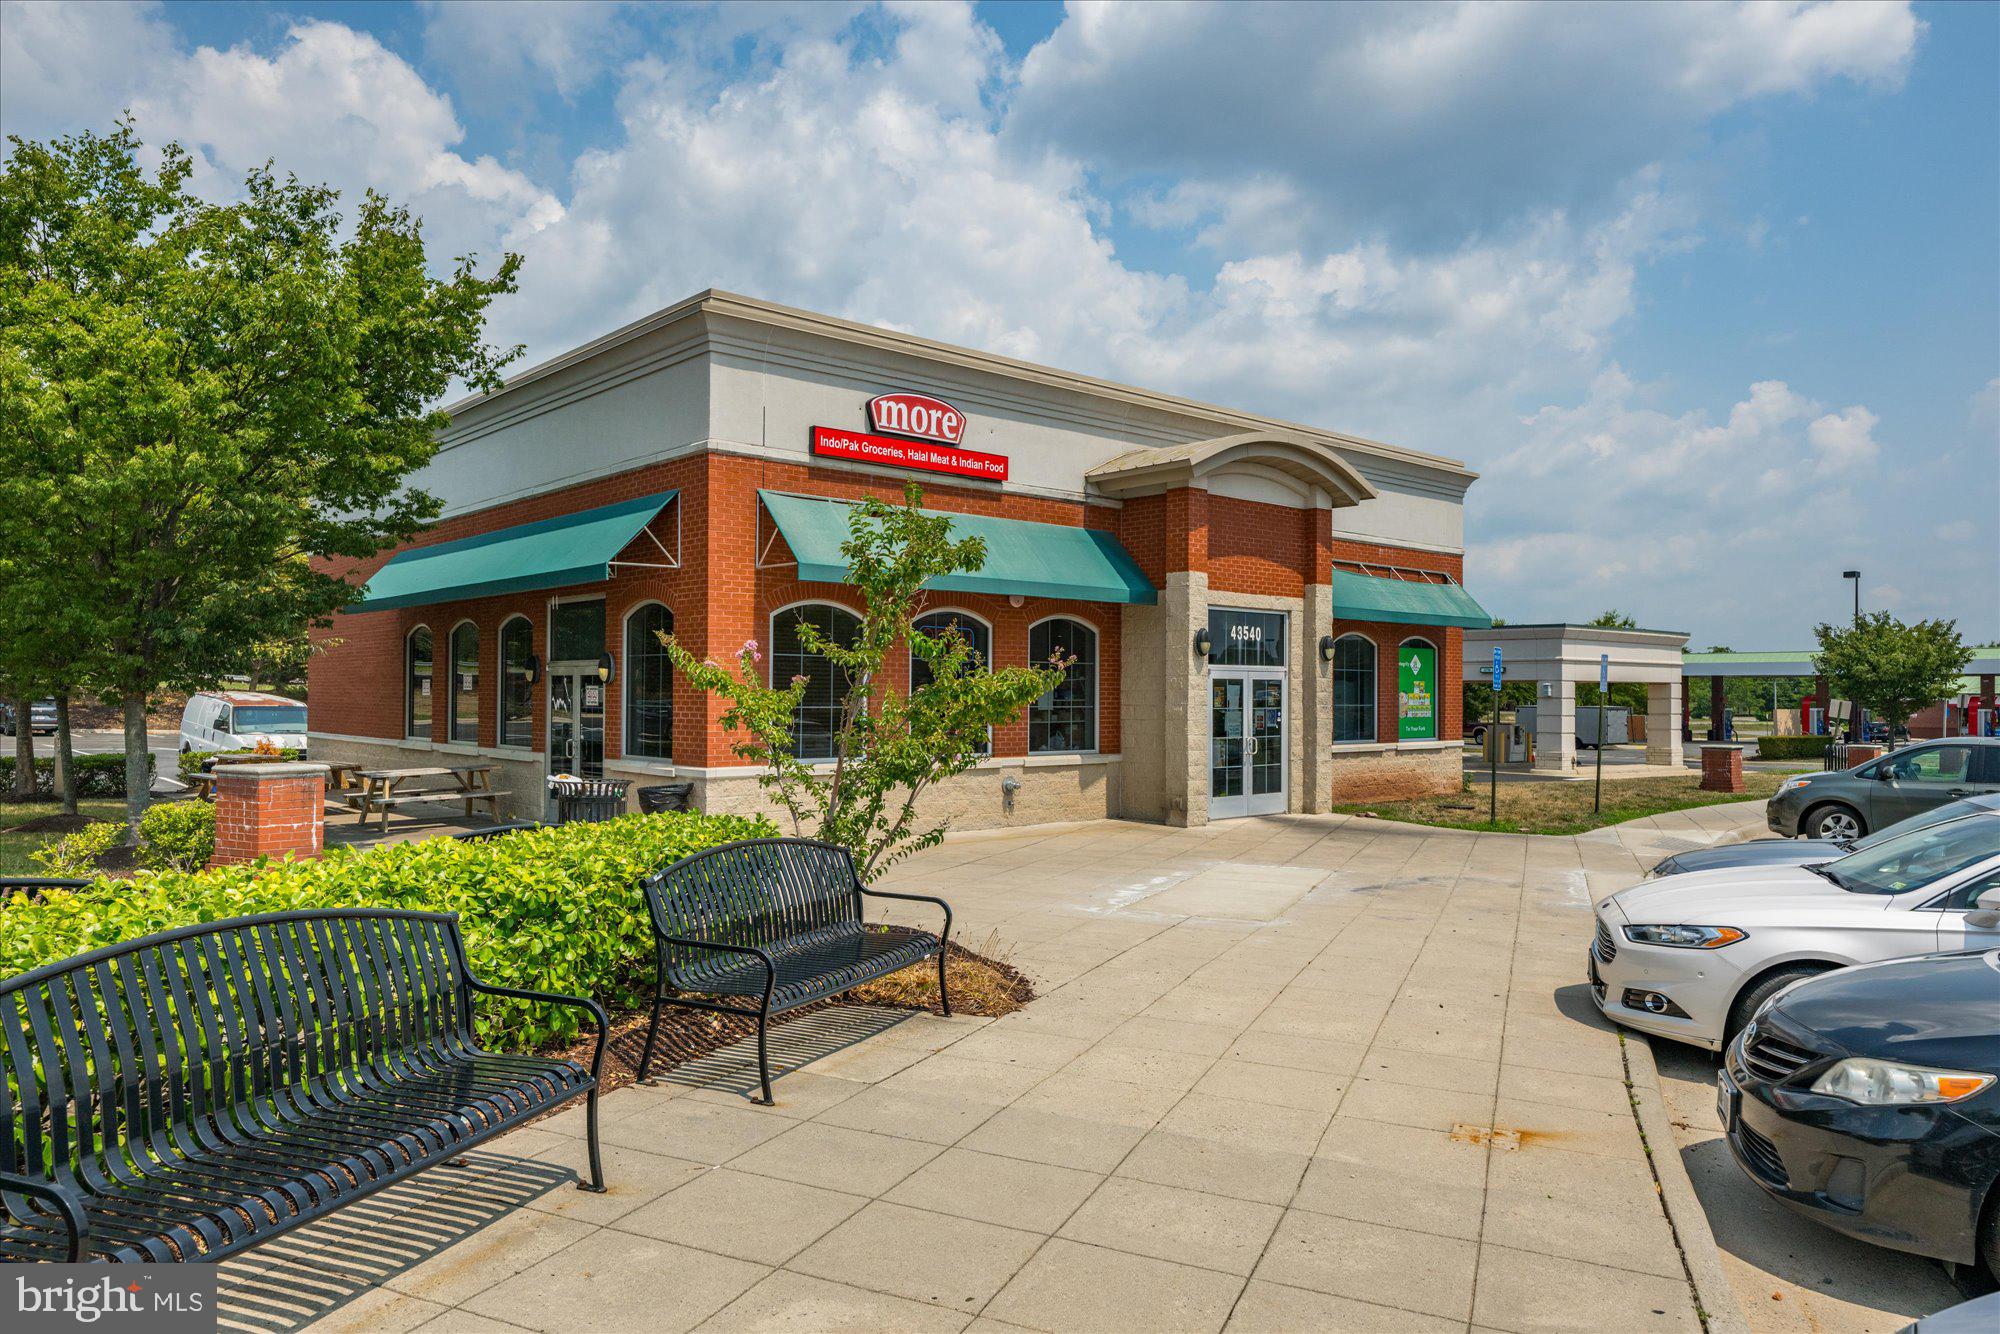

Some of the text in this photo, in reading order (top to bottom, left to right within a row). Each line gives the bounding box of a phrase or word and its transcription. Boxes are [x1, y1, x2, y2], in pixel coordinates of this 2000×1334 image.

[879, 400, 957, 438] more
[820, 435, 1004, 473] Indo/Pak Groceries, Halal Meat & Indian Food
[1231, 625, 1261, 641] 43540
